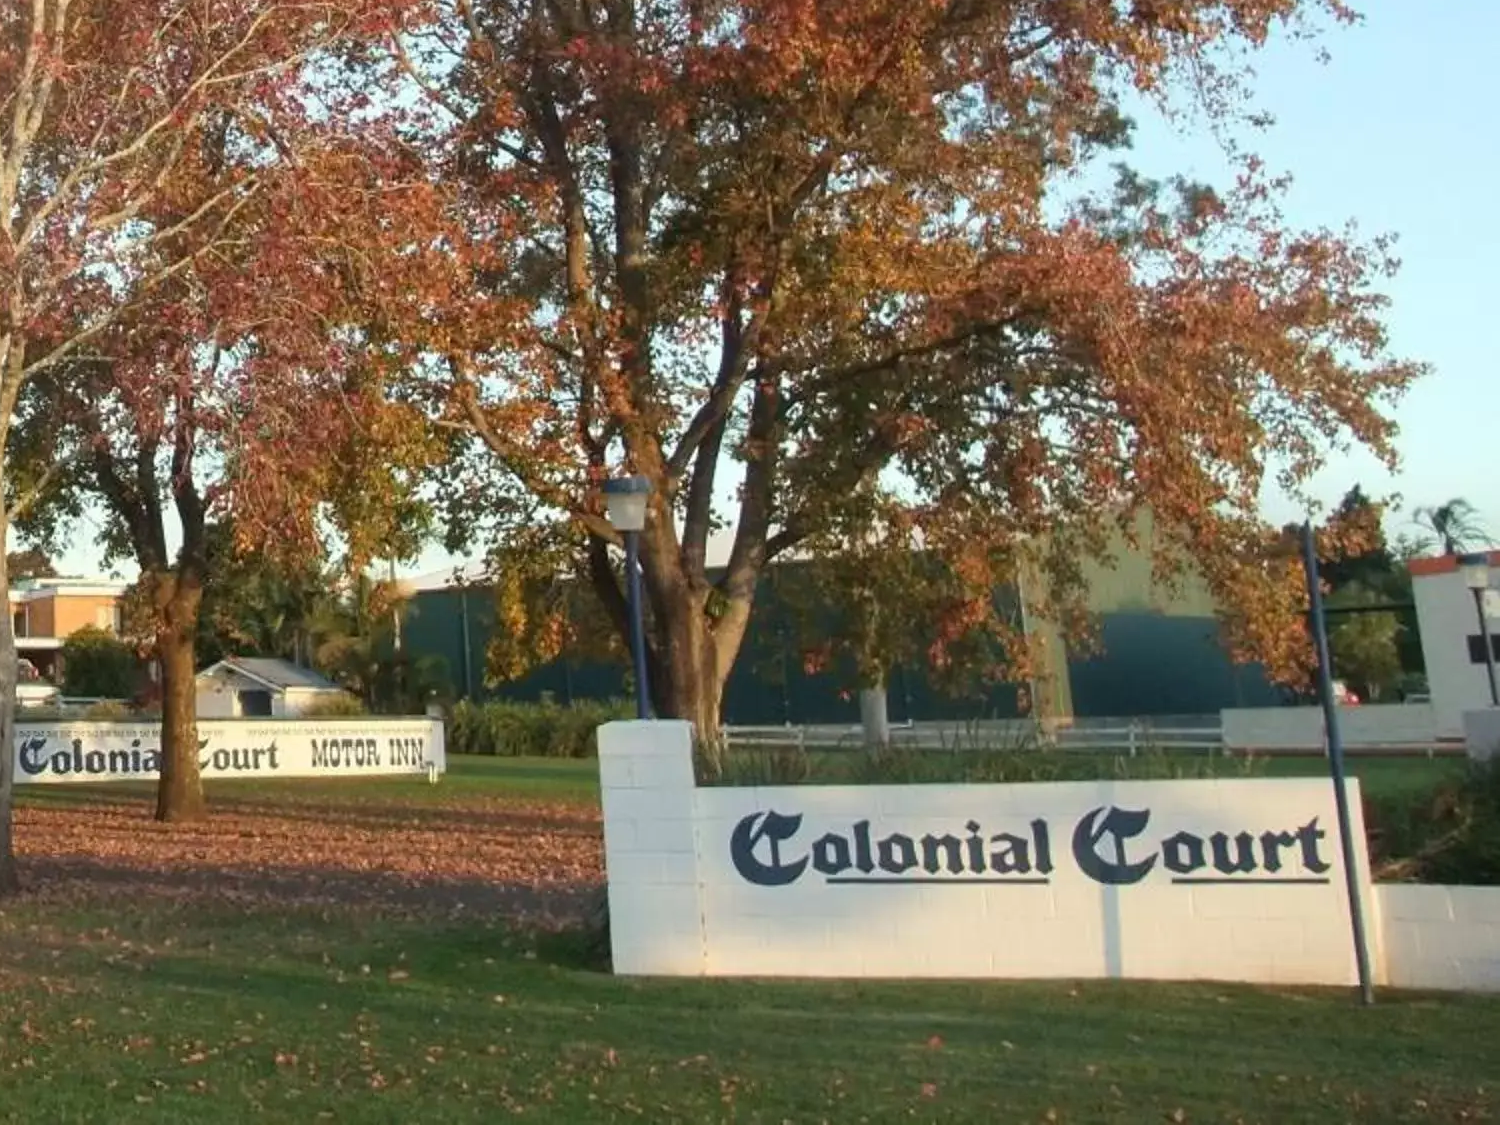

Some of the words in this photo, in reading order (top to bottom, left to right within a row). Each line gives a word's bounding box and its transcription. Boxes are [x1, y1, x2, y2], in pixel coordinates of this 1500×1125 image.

[19, 738, 162, 775] Colonia
[311, 738, 381, 768] MOTOR
[389, 738, 425, 766] INN
[730, 810, 1054, 886] Colonial
[1072, 805, 1332, 885] Court
